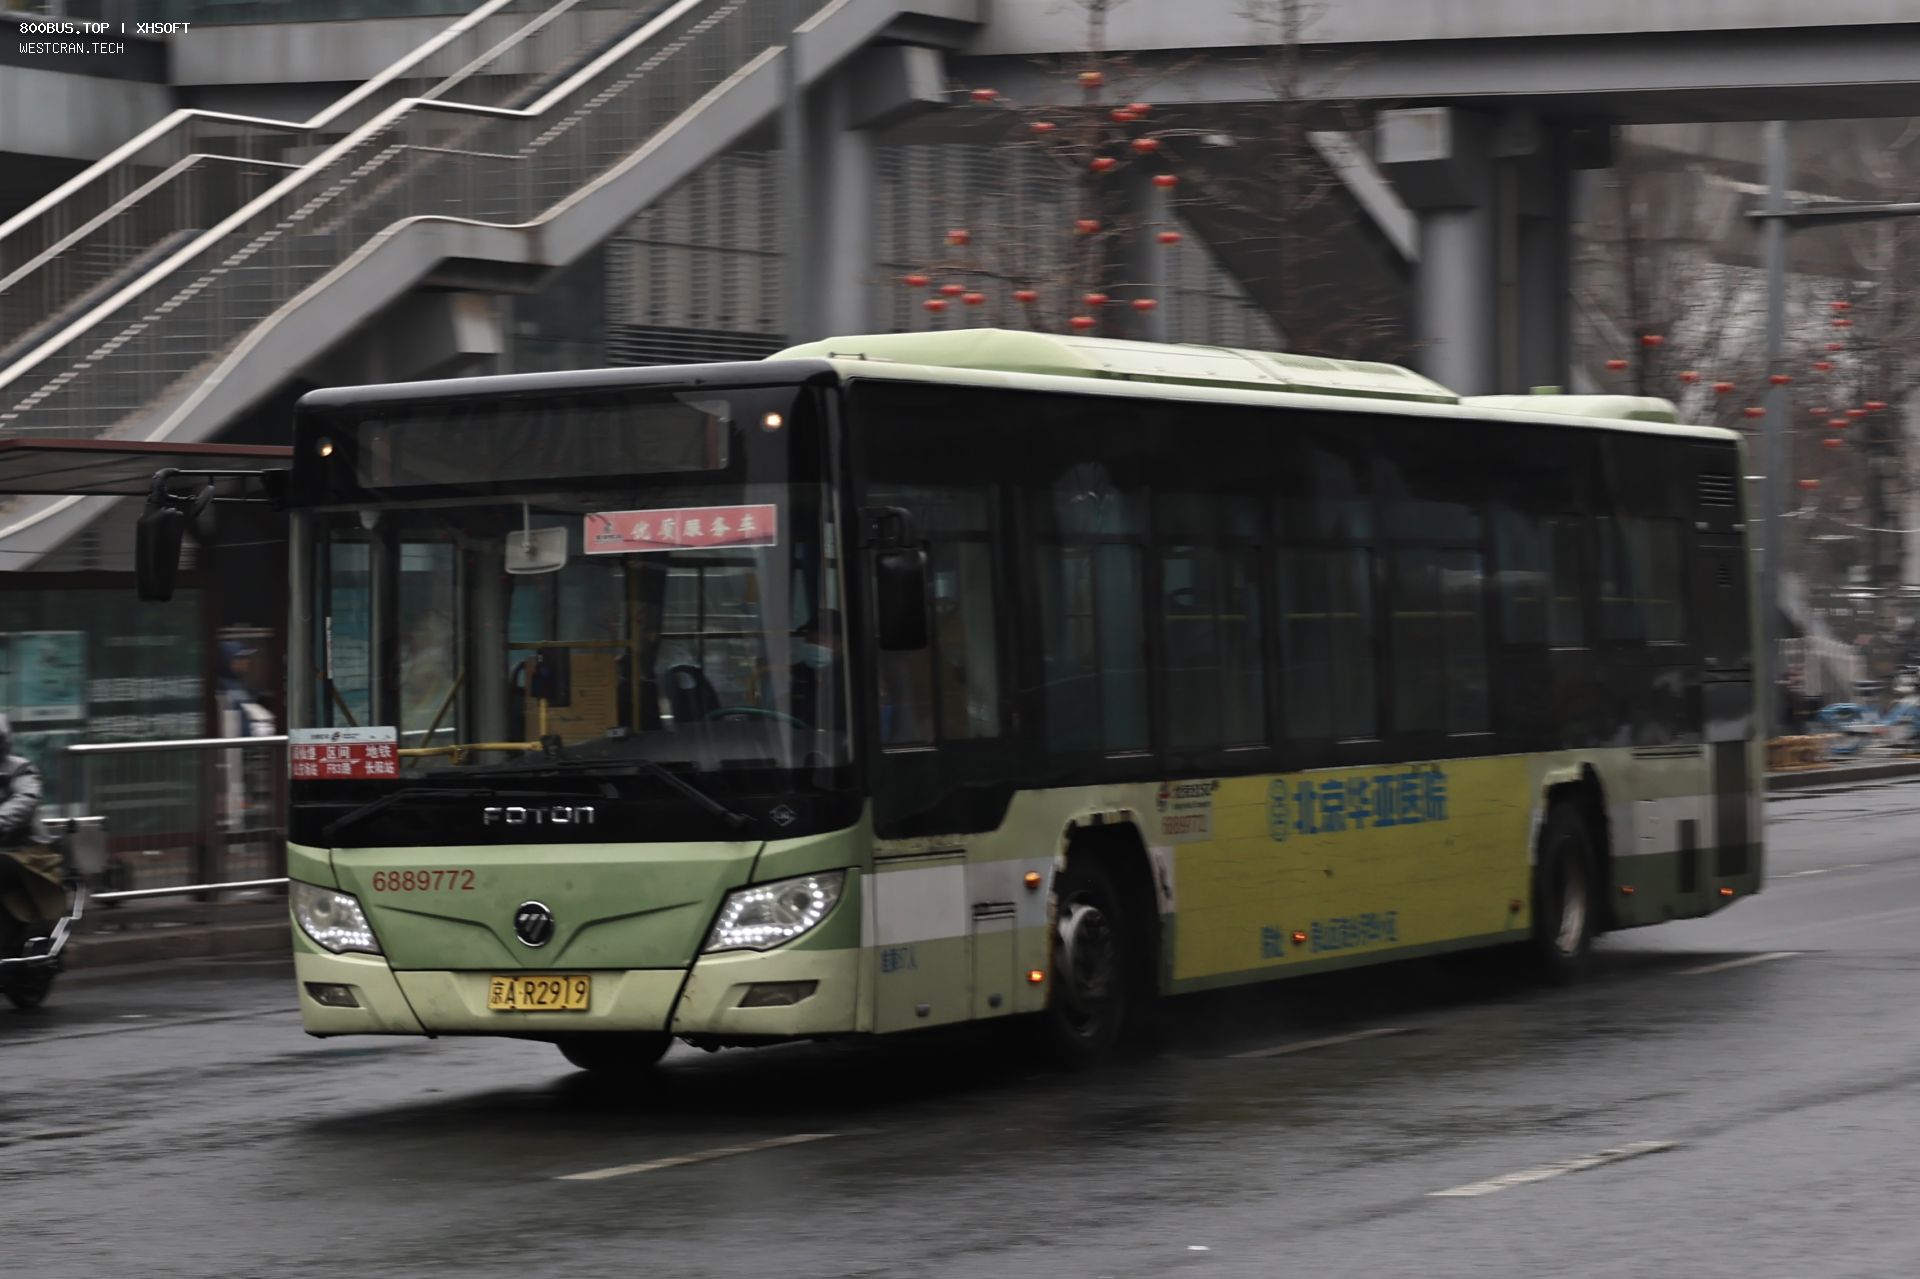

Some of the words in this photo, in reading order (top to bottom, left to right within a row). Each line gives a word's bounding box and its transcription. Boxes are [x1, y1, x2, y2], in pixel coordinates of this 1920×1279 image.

[631, 513, 757, 541] 优质服务车
[326, 746, 351, 760] 区间
[365, 744, 392, 759] 地铁
[365, 760, 395, 775] 长阳站
[1294, 771, 1448, 834] 北京华亚医院
[372, 869, 476, 892] 6889772
